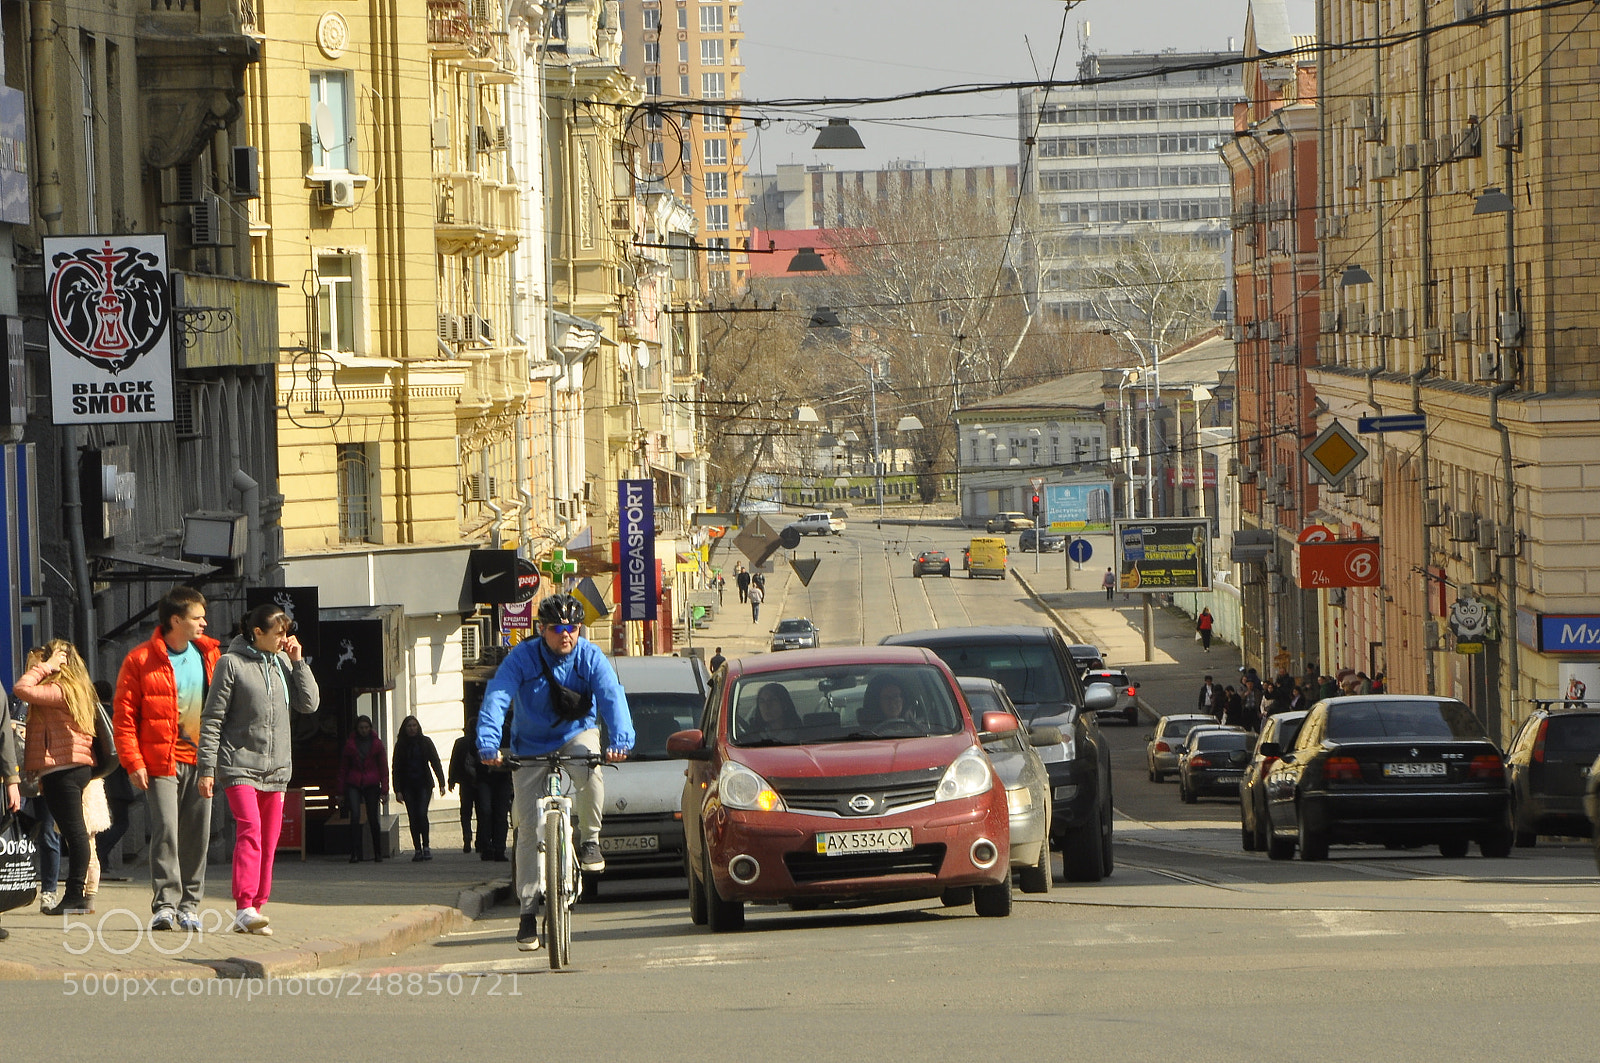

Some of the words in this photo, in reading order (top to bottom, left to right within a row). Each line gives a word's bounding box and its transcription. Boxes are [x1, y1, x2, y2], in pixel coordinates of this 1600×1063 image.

[72, 381, 154, 395] BLACK
[72, 394, 156, 415] SMOKE
[626, 482, 646, 601] MEGASPORT
[1311, 570, 1330, 585] 24h
[1560, 623, 1600, 645] Му
[640, 837, 656, 848] BC
[828, 835, 848, 849] AX
[852, 832, 885, 848] 5334
[888, 831, 909, 846] CX
